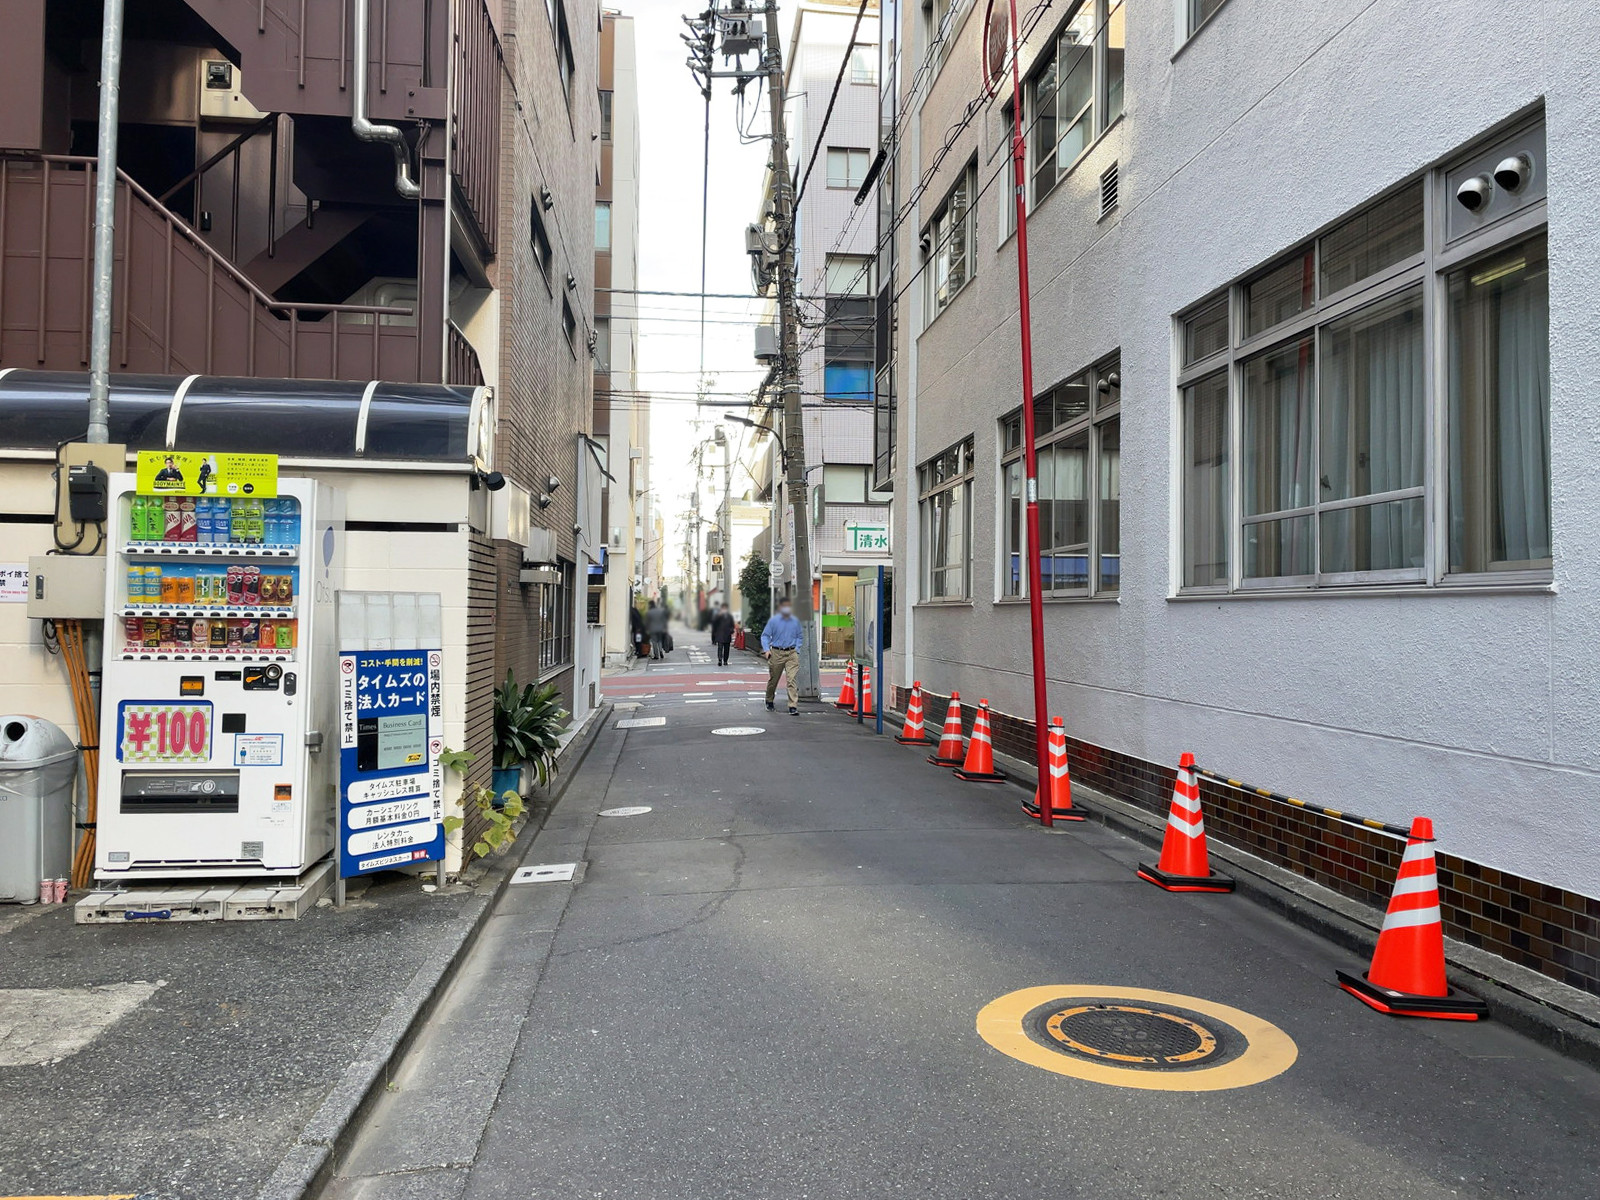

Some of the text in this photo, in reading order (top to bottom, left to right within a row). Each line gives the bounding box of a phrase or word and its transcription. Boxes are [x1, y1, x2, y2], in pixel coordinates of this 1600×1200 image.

[860, 534, 887, 548] 清水
[358, 673, 425, 690] タイムズの
[358, 691, 426, 710] 法人カード
[430, 669, 440, 717] 場内禁煙
[344, 678, 353, 744] ゴミ捨て禁止
[359, 723, 377, 731] Times
[383, 719, 422, 729] Business Card
[128, 710, 206, 755] ¥100
[366, 802, 419, 817] カーシェアリング
[377, 829, 410, 841] レンタカー
